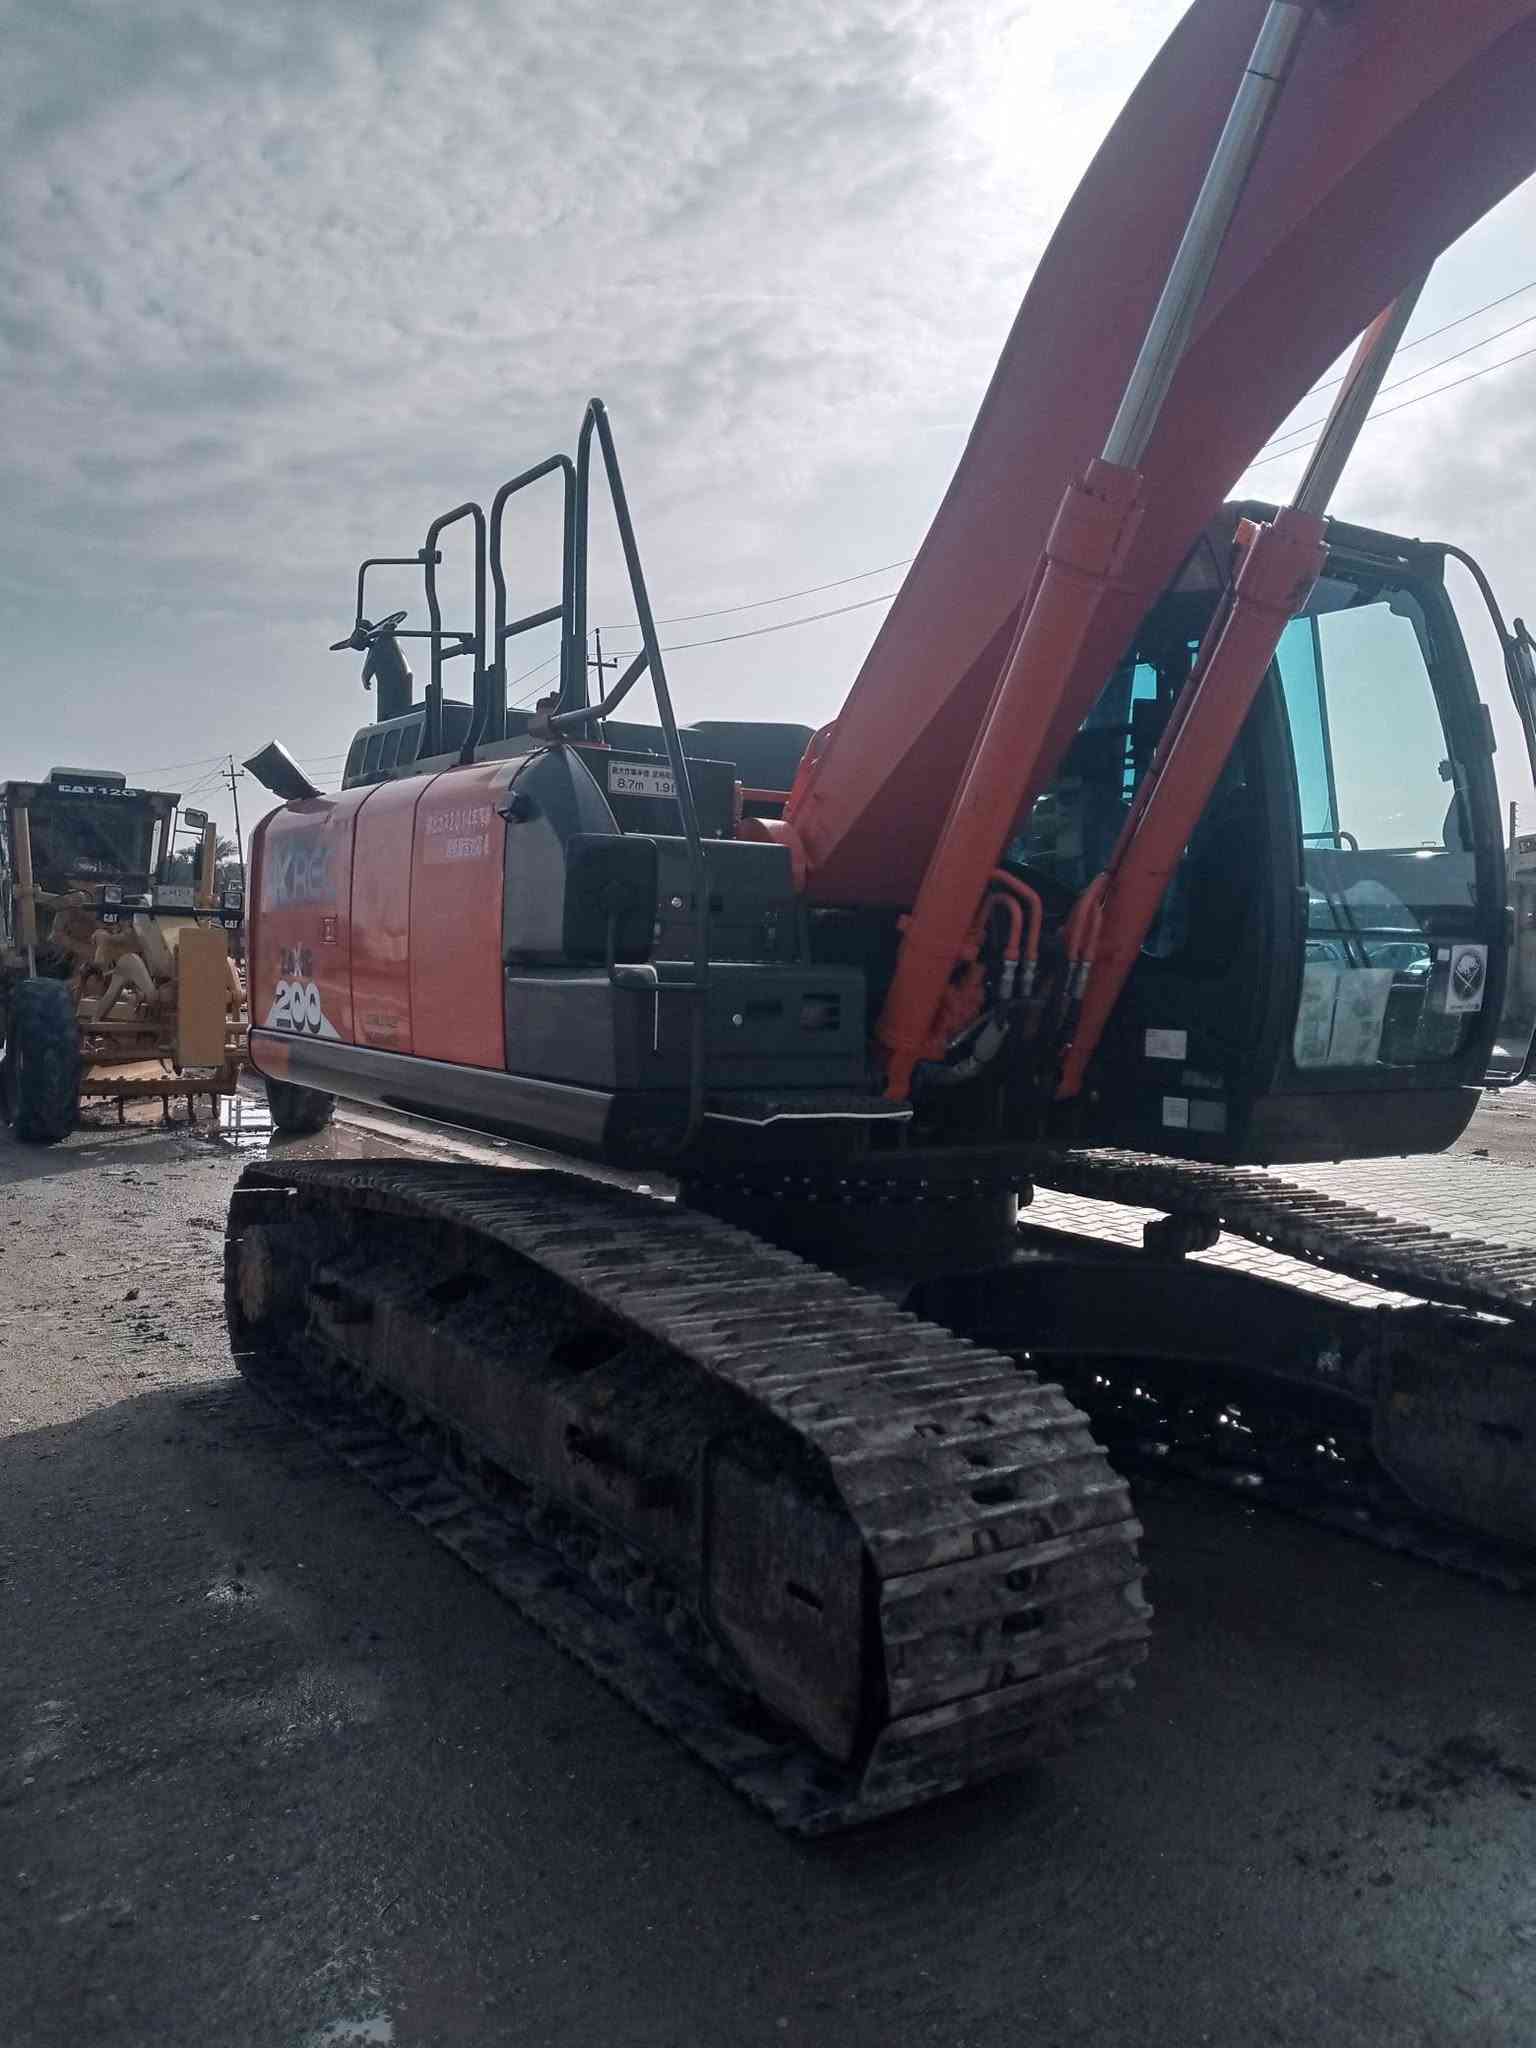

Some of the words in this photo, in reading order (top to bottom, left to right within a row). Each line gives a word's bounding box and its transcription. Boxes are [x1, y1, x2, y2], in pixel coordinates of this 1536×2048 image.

[58, 784, 96, 794] CAT
[98, 787, 137, 797] 12G
[617, 778, 645, 791] 8.7m
[103, 913, 118, 923] CAT
[224, 919, 239, 929] CAT
[274, 979, 322, 1034] 200
